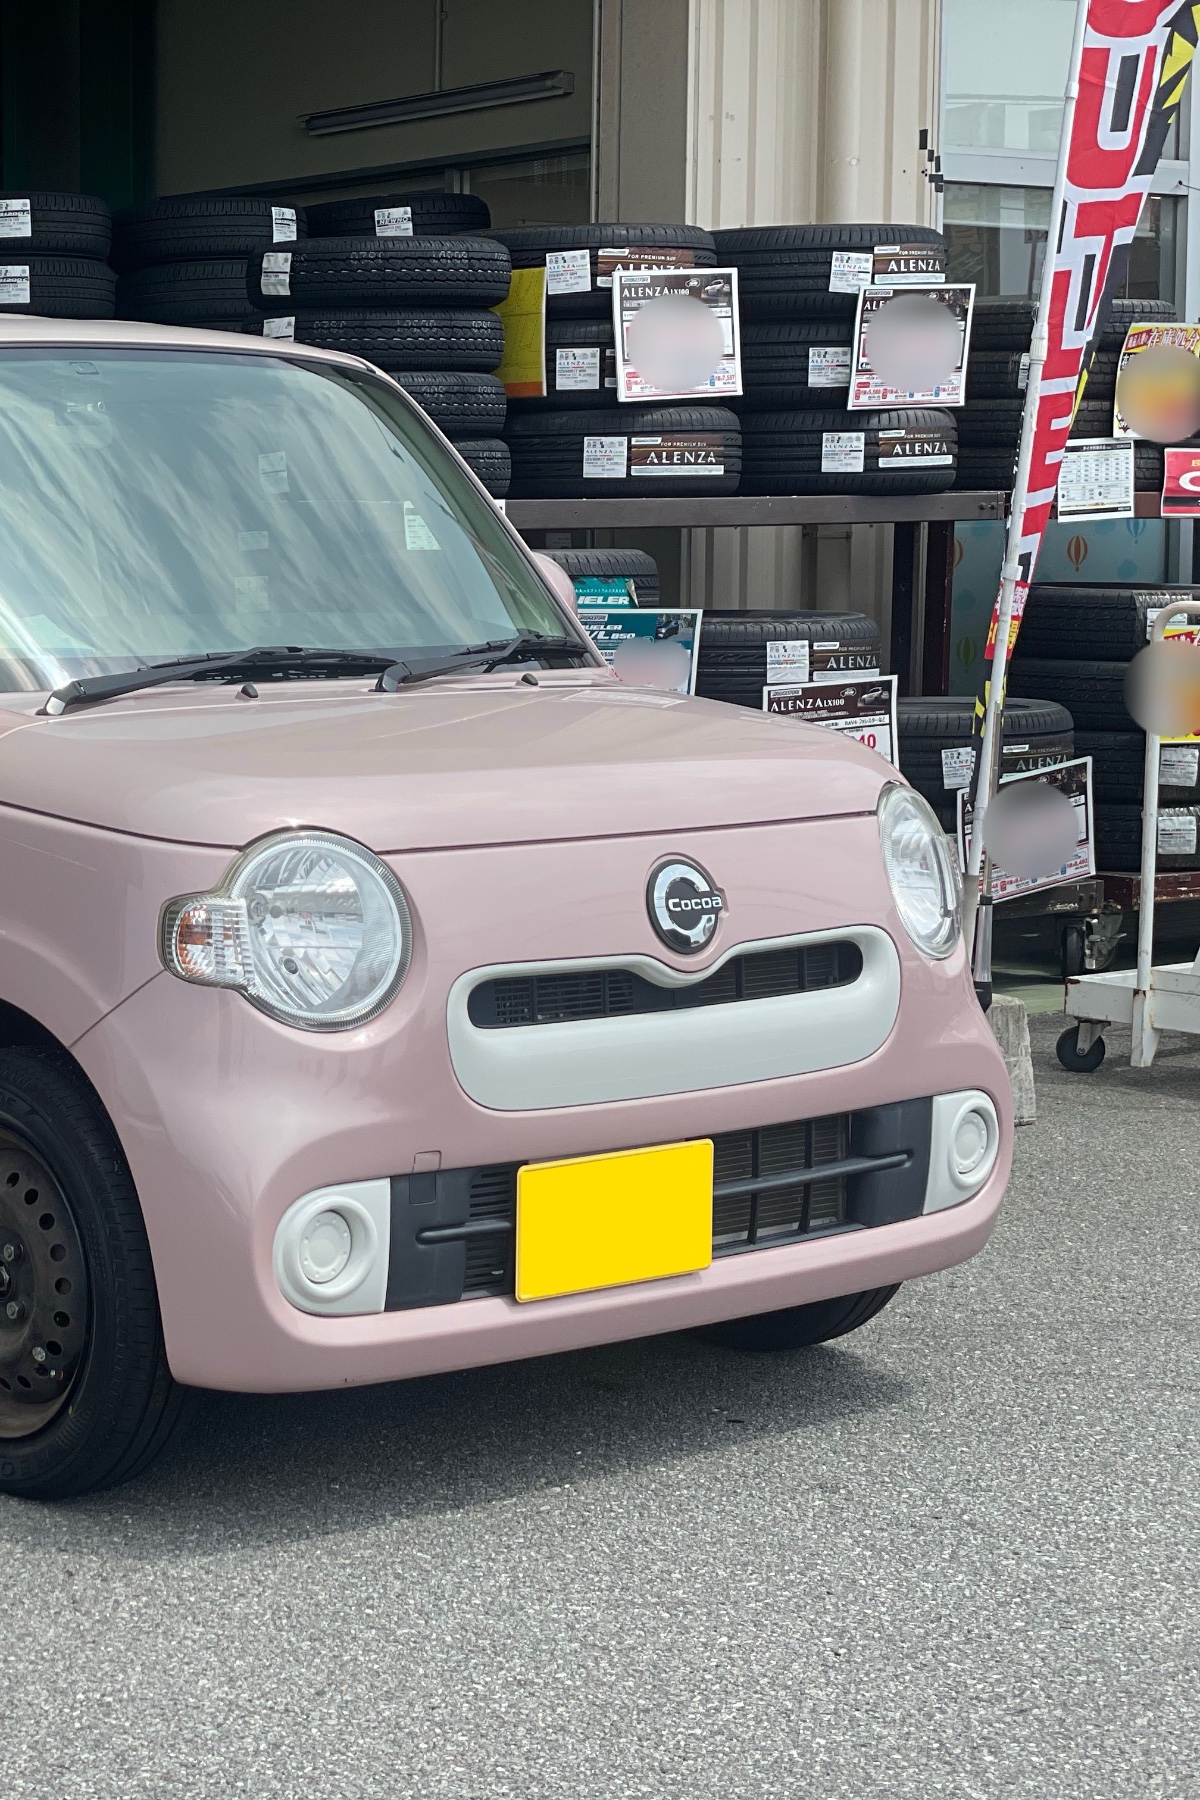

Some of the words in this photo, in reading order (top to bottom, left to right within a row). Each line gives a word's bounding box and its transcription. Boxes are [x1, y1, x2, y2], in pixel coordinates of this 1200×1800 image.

[888, 259, 940, 272] ALENZA
[622, 286, 669, 298] ALENZA
[892, 442, 948, 456] ALENZA
[646, 451, 716, 464] ALENZA
[577, 595, 630, 605] ELER
[826, 655, 877, 669] ALENZA
[770, 698, 823, 712] ALENZA
[823, 698, 845, 707] LX100
[668, 896, 723, 912] Cocoa
